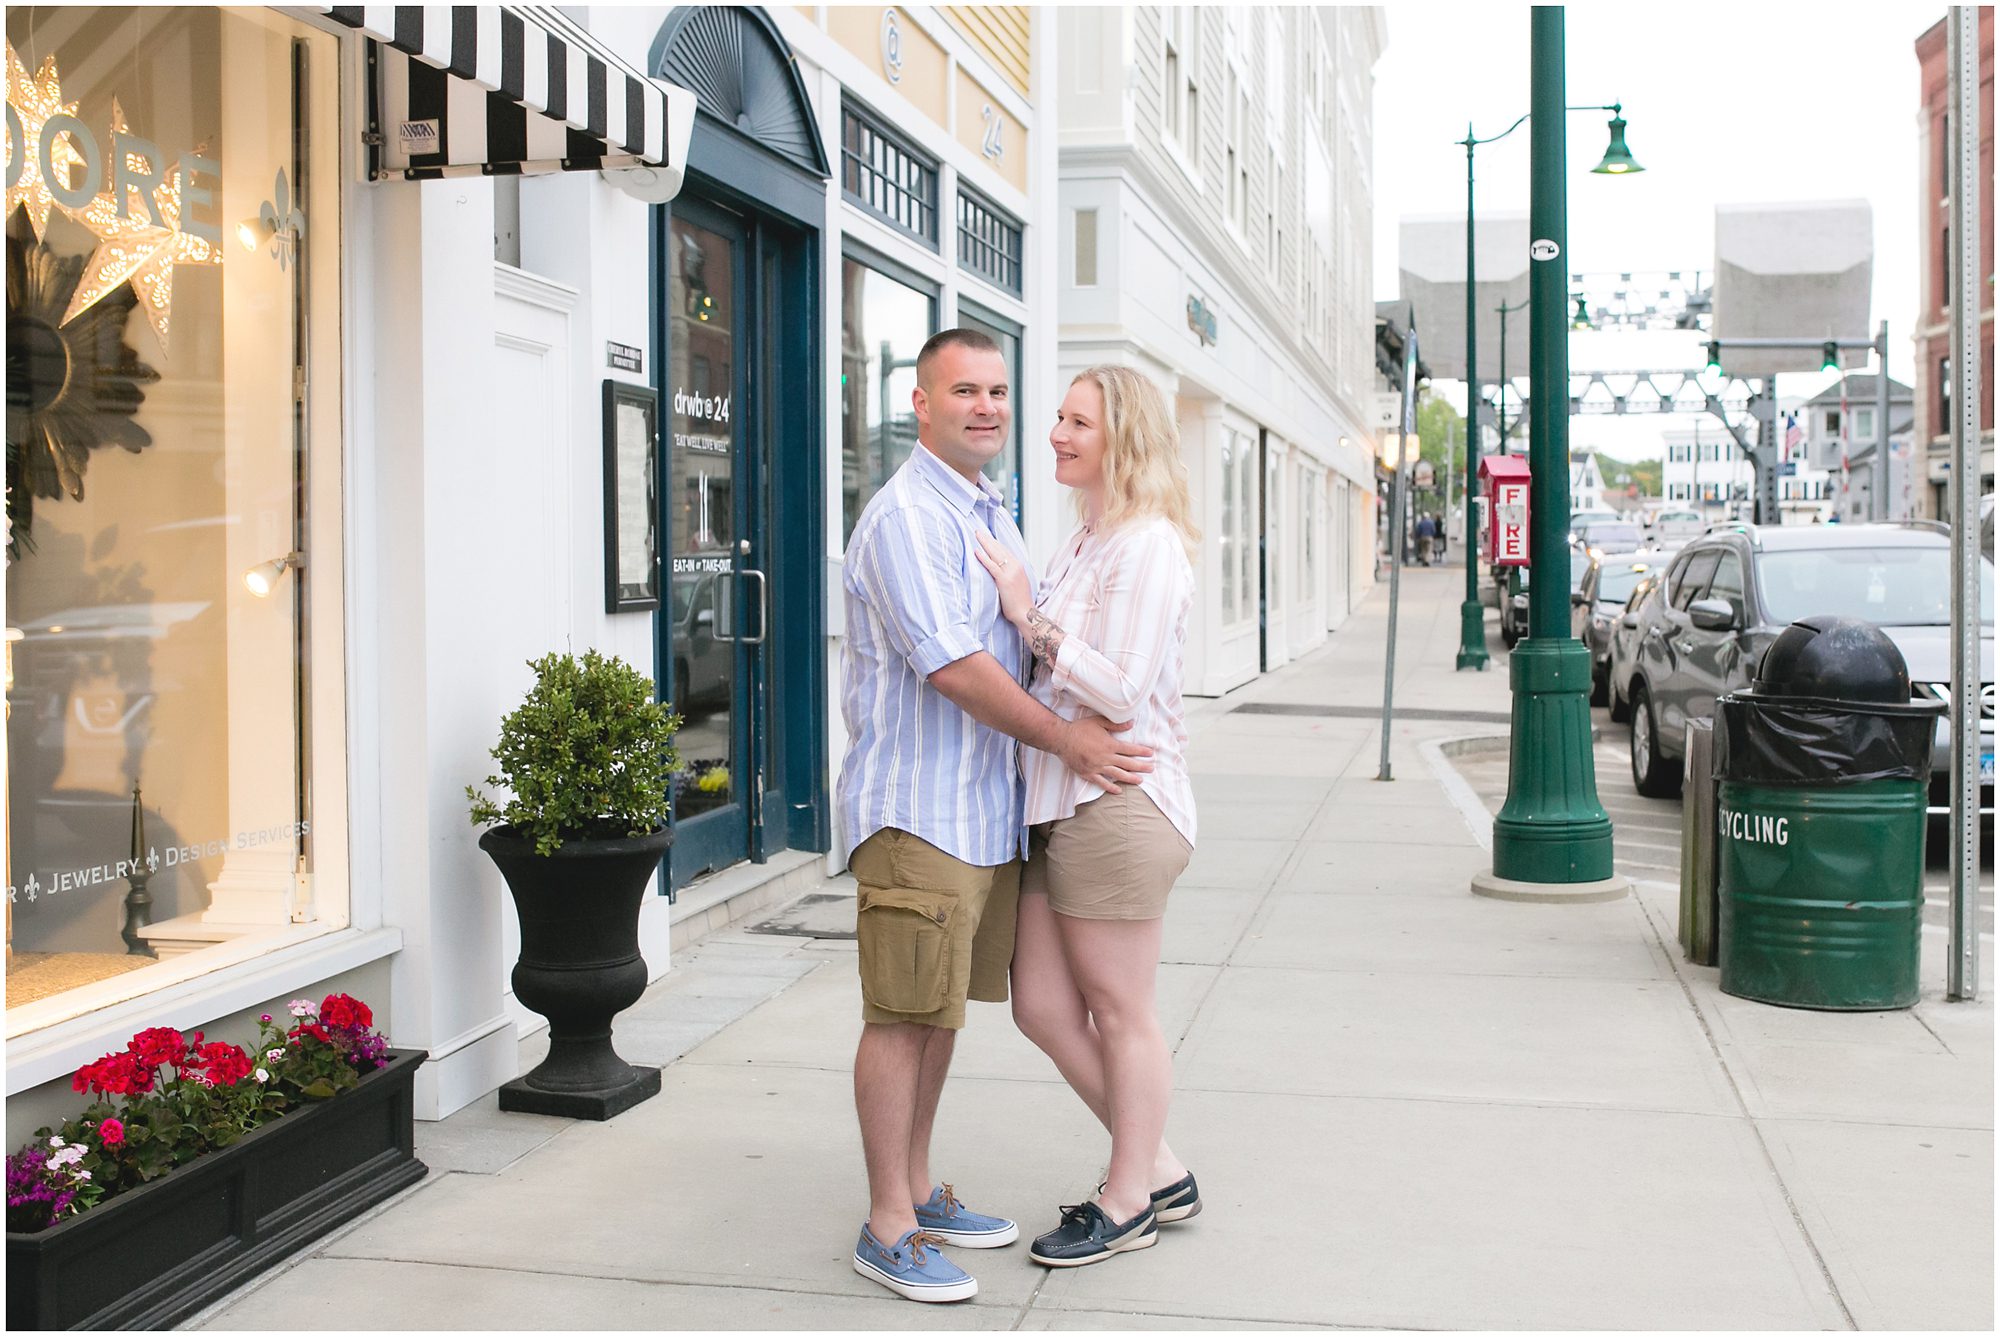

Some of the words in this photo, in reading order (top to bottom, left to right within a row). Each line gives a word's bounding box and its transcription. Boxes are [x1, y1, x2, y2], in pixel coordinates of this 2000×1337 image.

[982, 103, 1003, 167] 24
[675, 387, 703, 418] drwb
[704, 398, 713, 420] @
[714, 395, 729, 423] 24
[1506, 489, 1520, 555] FRE
[674, 559, 695, 572] EAT-IN
[1719, 808, 1788, 846] CYCLING
[47, 857, 140, 895] JEWELRY
